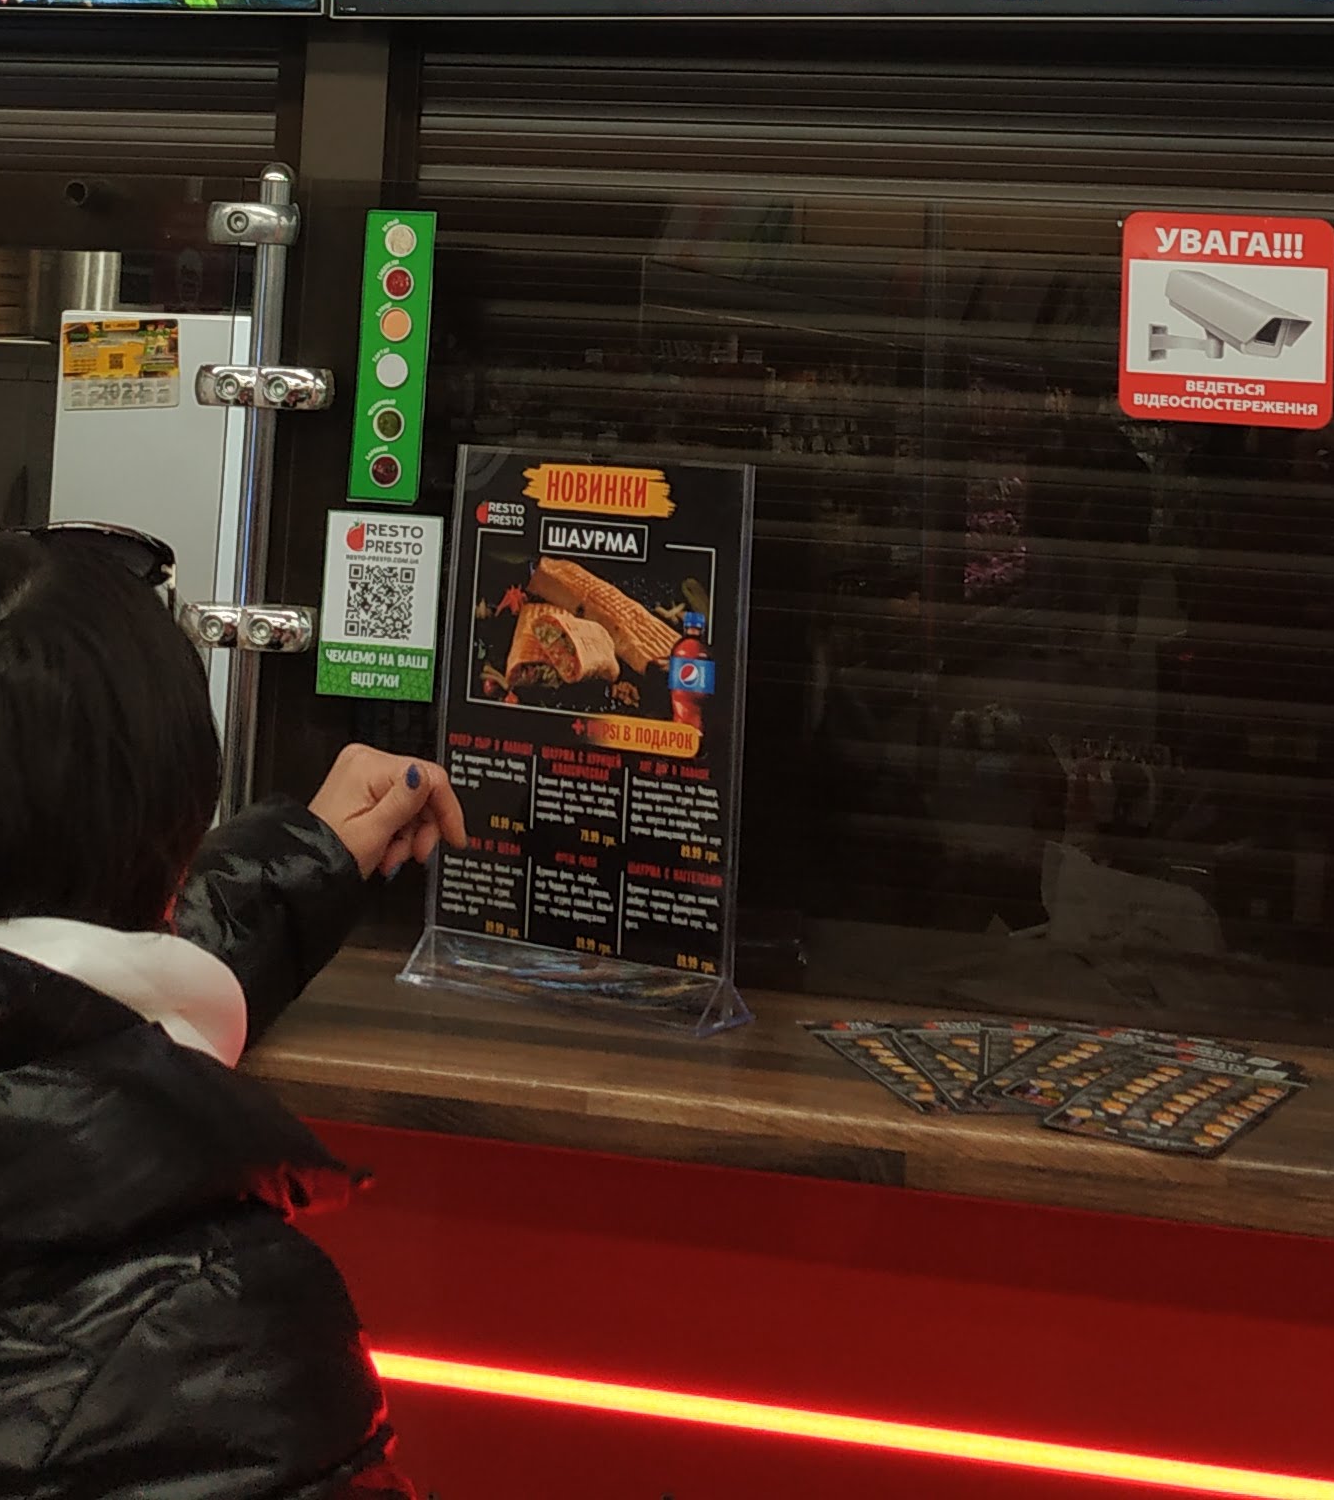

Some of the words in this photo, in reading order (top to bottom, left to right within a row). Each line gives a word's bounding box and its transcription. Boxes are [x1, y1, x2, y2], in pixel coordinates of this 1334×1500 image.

[1155, 227, 1304, 260] УВАГА!!!
[1186, 380, 1265, 396] ВЕДЕТЬСЯ
[1133, 393, 1318, 416] ВІДЕОСПОСТЕРЕЖЕННЯ
[546, 470, 648, 509] НОВИНКИ
[488, 502, 525, 514] RESTO
[487, 514, 524, 526] PRESTO
[366, 523, 423, 538] RESTO
[365, 541, 422, 555] PRESTO
[548, 526, 638, 554] ШАУРМА
[326, 648, 376, 664] ЧЕКАЕМО
[379, 653, 395, 666] НА
[398, 654, 428, 669] ВАШІ
[351, 672, 399, 688] ВІДГУКИ
[624, 725, 630, 742] В
[636, 727, 692, 750] ПОДАРОК
